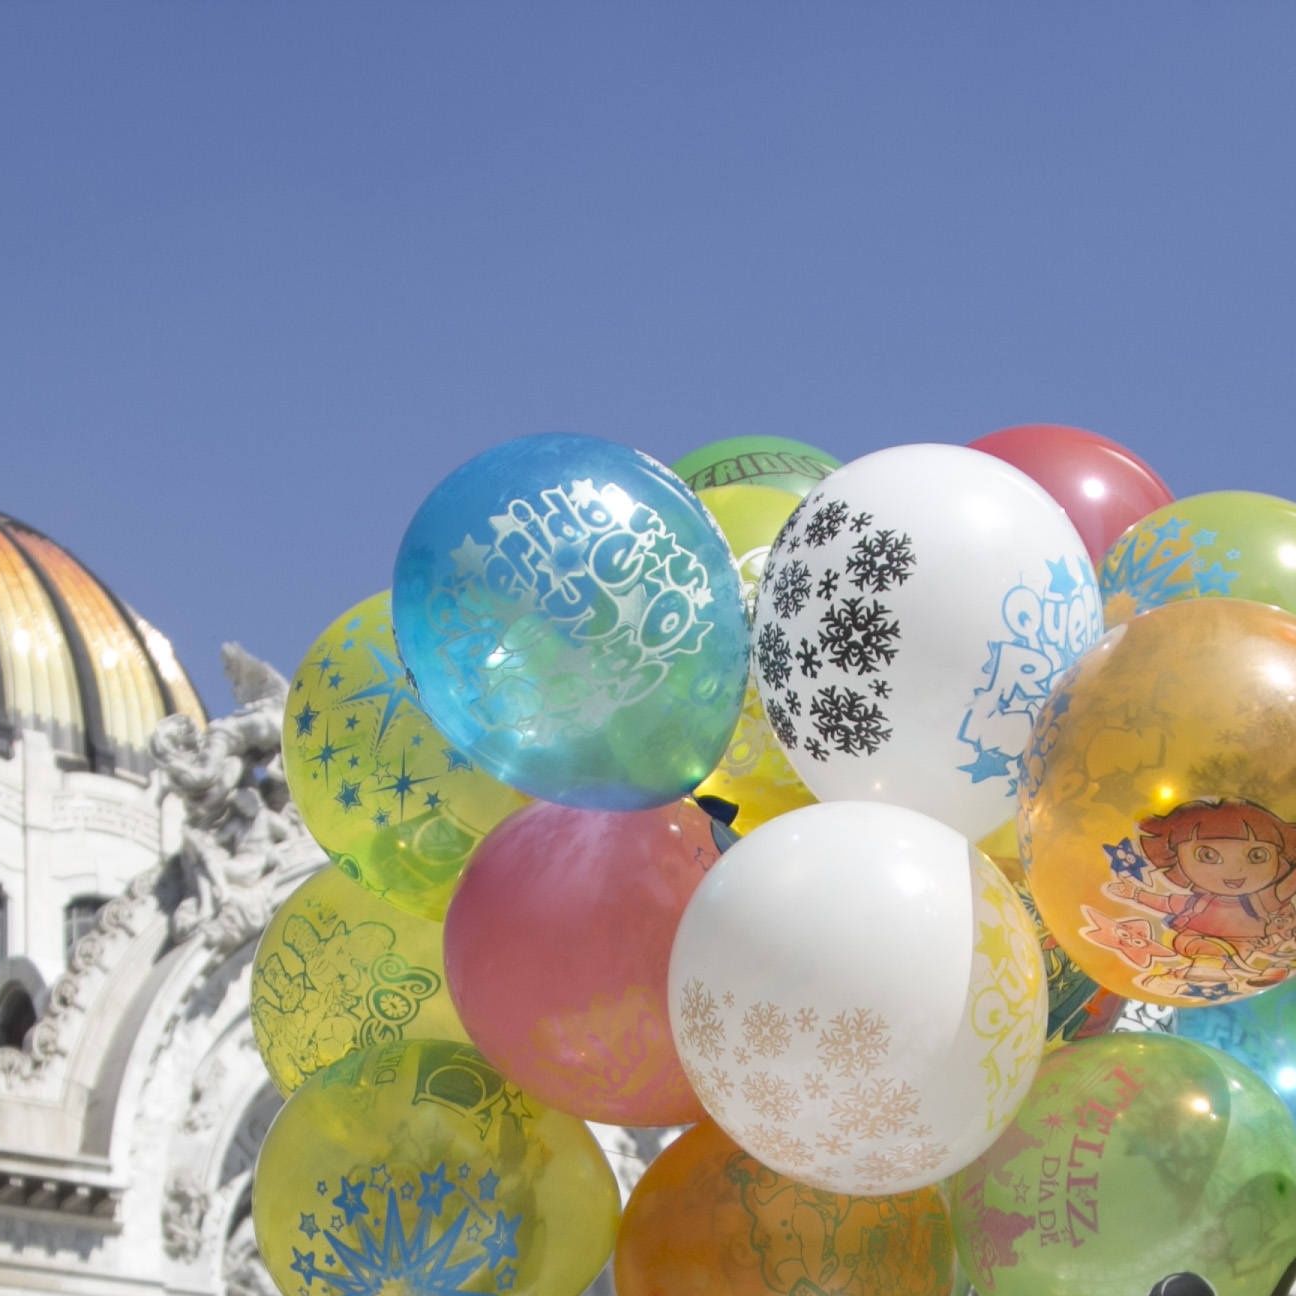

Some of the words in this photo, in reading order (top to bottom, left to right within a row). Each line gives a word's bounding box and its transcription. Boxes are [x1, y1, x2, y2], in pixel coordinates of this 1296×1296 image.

[685, 452, 836, 492] ERIDO
[1001, 583, 1104, 656] Quer
[1038, 1155, 1062, 1204] DÍA
[1065, 1063, 1146, 1249] FELIZ
[1038, 1209, 1061, 1248] DE
